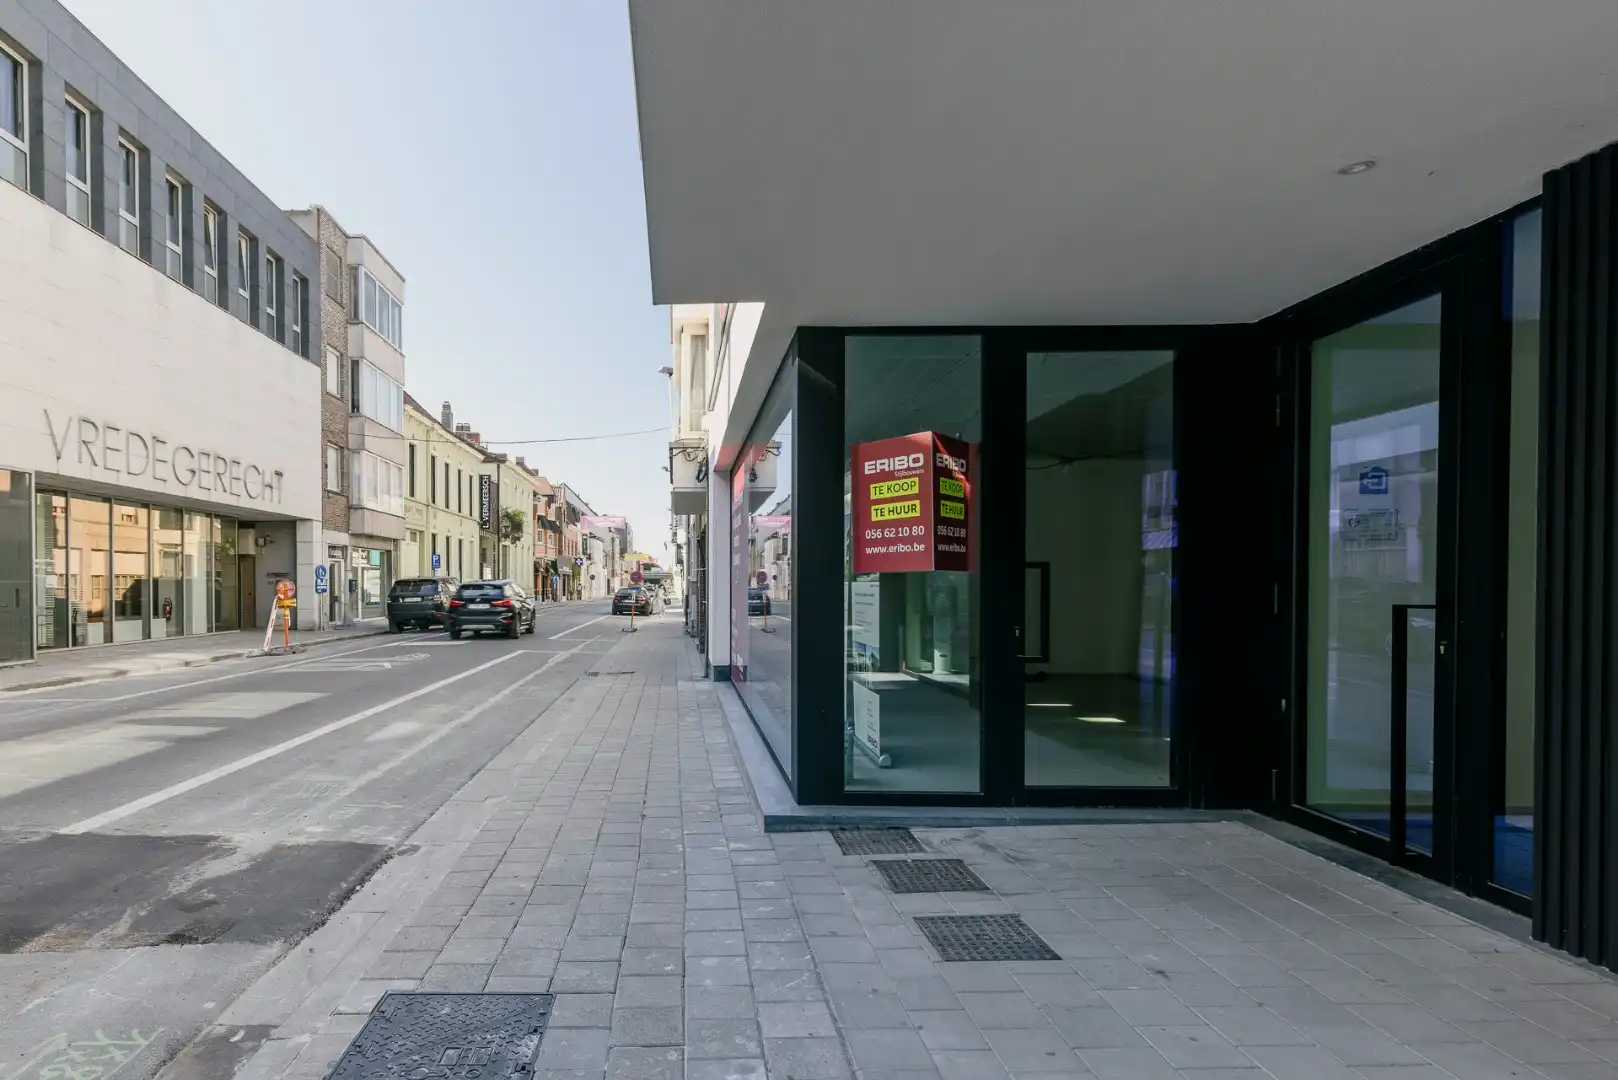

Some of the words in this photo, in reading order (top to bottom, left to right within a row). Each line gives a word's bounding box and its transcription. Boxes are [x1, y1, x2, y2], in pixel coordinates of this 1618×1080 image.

[44, 409, 283, 504] VREDEGERECHT
[865, 453, 924, 474] ERIBO
[936, 452, 966, 472] ERIBO
[872, 486, 884, 496] TE
[887, 480, 917, 494] KOOP
[941, 480, 948, 491] TE
[482, 475, 490, 521] VERMEERSCH
[873, 507, 885, 517] TE
[888, 504, 917, 516] HUUR
[942, 503, 949, 514] TE
[865, 529, 882, 539] 056
[884, 527, 896, 538] 62
[898, 526, 909, 537] 10
[912, 525, 925, 536] 80
[865, 542, 925, 554] www.eribo.be
